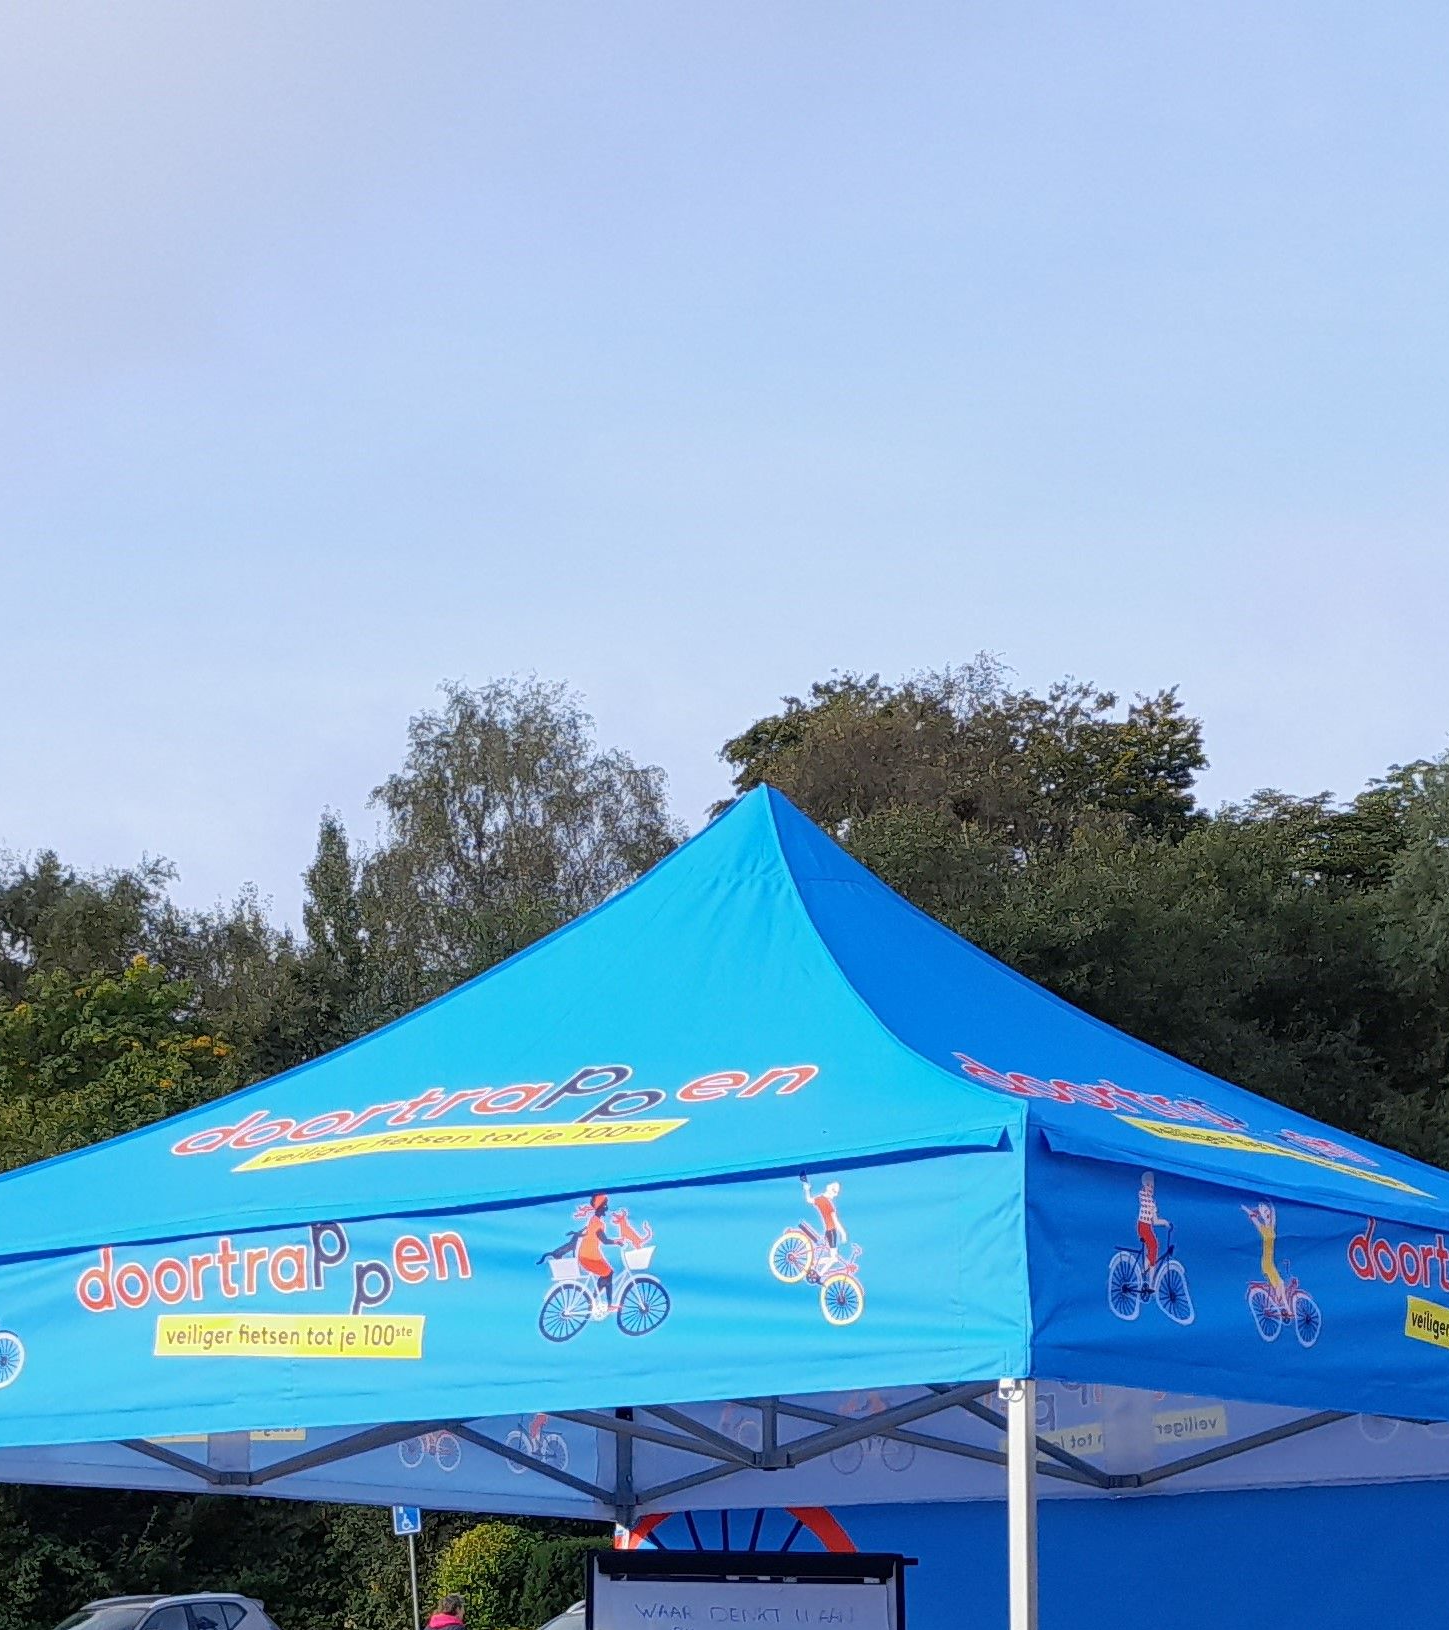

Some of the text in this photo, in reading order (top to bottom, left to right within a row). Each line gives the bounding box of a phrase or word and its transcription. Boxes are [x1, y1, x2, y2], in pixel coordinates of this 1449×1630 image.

[171, 1065, 819, 1156] doortrappen
[260, 1124, 663, 1165] veiliger fietsen tot je 100ste
[77, 1222, 471, 1315] doortrappen
[166, 1324, 413, 1351] veiliger fietsen tot je 100ste
[1411, 1311, 1449, 1340] veiliger
[635, 1603, 694, 1620] WAAR
